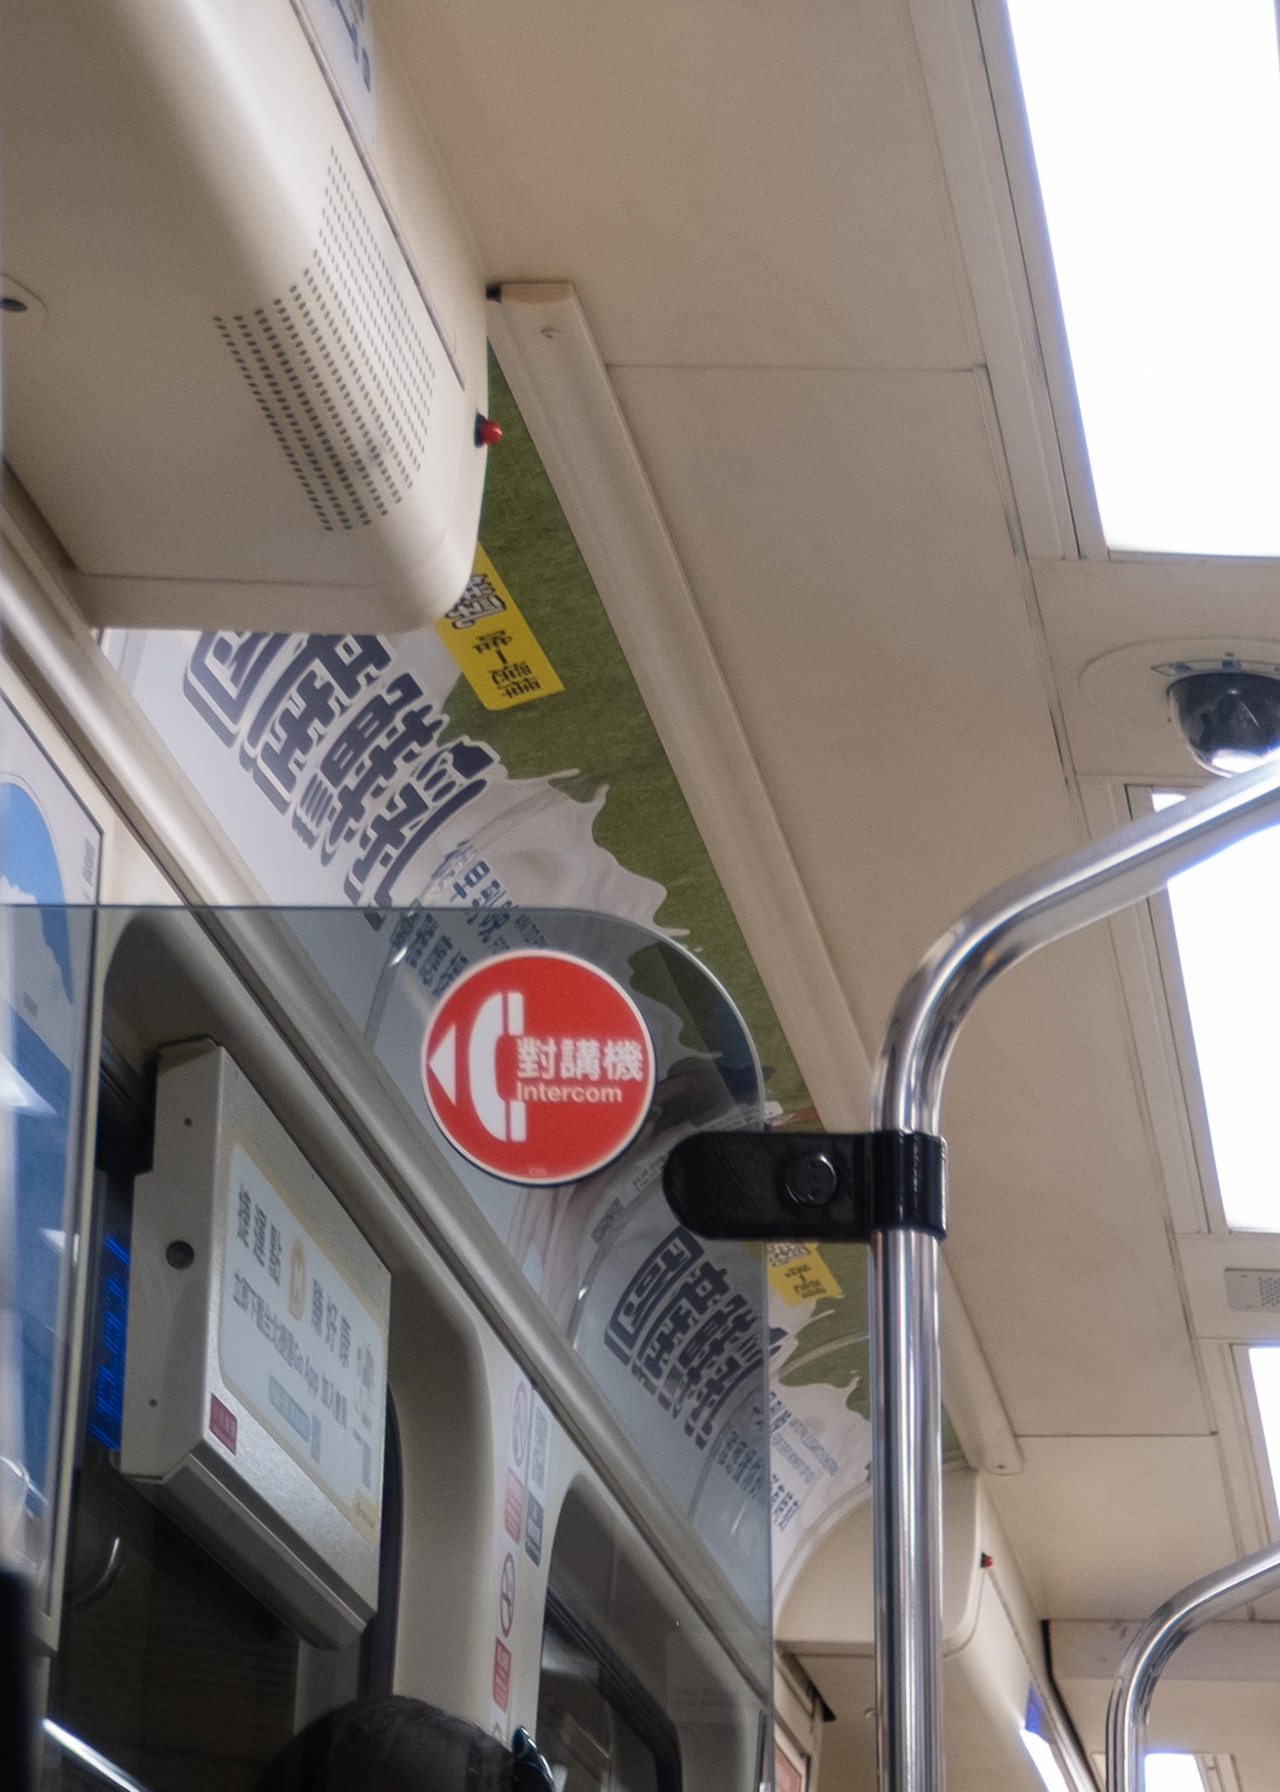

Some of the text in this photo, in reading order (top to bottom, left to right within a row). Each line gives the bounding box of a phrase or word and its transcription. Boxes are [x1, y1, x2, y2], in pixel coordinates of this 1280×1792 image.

[516, 1036, 643, 1082] 對講機
[516, 1081, 623, 1104] Intercom
